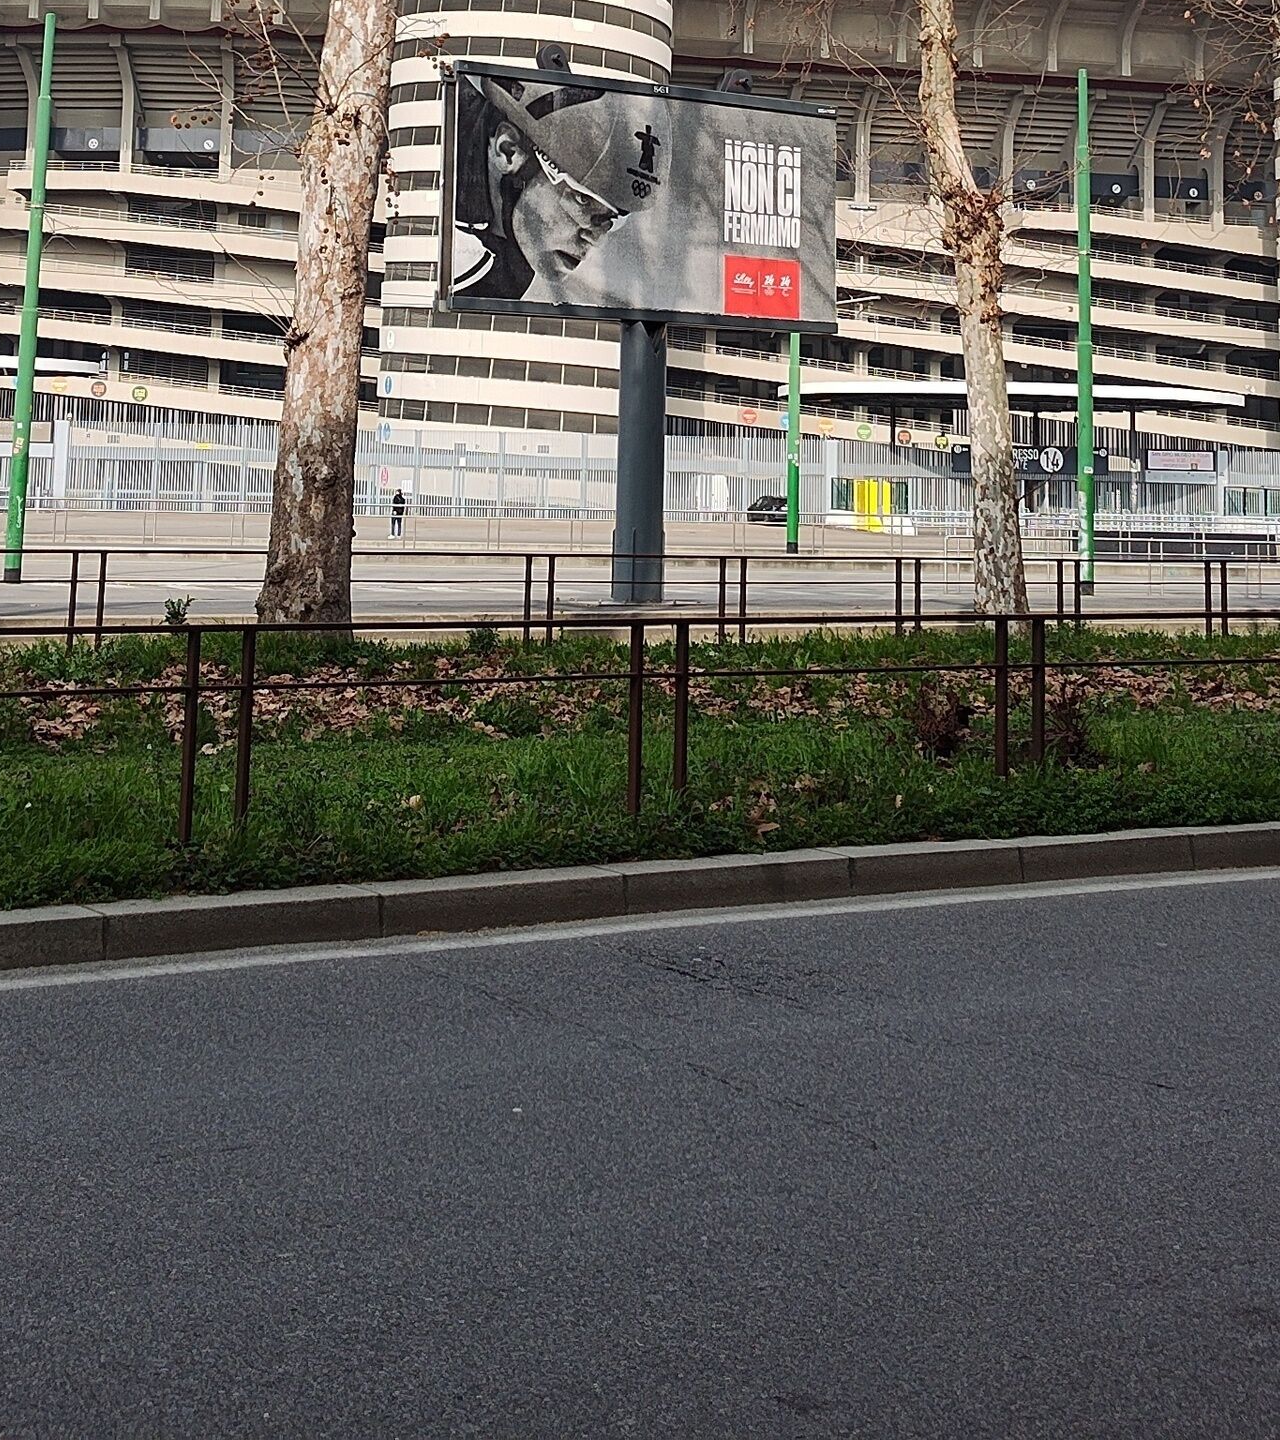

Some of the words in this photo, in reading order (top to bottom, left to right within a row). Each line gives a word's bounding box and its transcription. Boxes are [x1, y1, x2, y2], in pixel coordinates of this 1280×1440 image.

[724, 159, 774, 215] NON
[777, 166, 801, 217] CI
[724, 210, 801, 249] FERMIAMO
[1012, 448, 1039, 460] RESSO
[1043, 450, 1060, 469] 14
